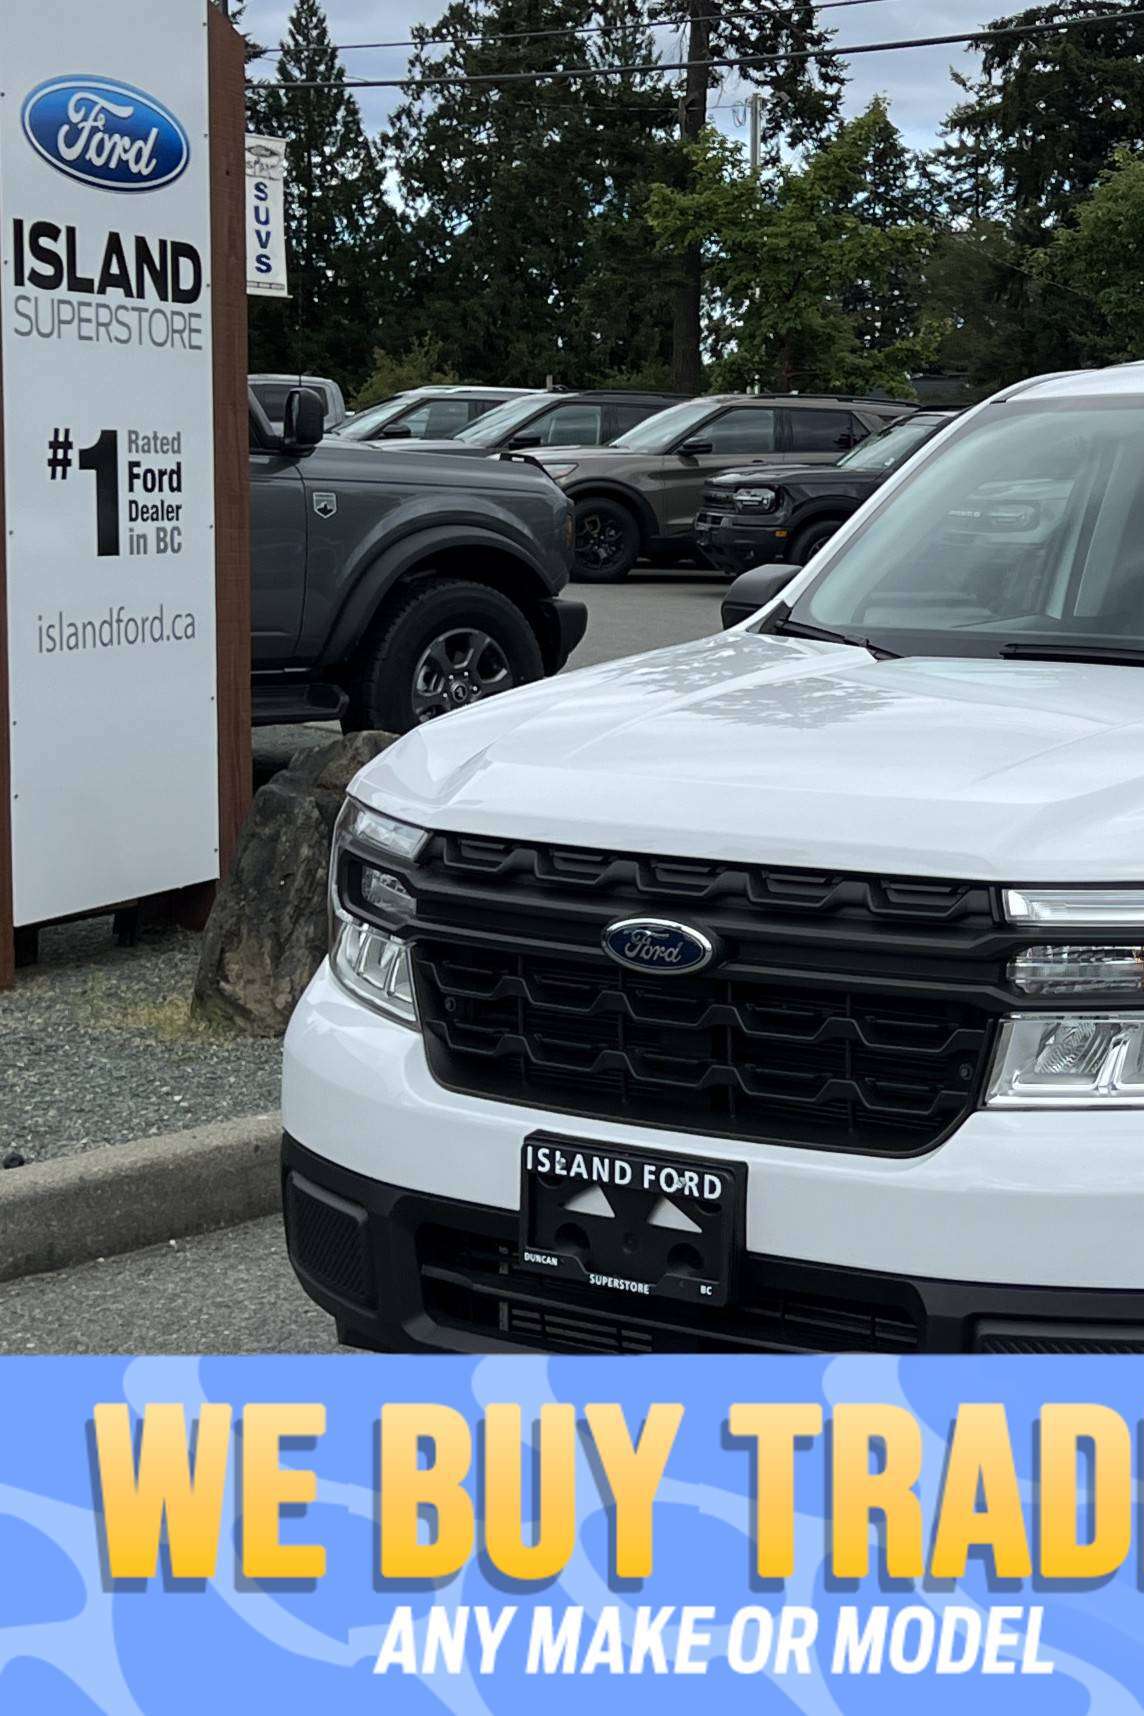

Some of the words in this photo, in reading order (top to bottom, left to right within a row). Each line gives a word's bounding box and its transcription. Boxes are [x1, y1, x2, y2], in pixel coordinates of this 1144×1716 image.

[57, 91, 158, 177] Ford
[253, 181, 273, 275] SUVS
[12, 217, 203, 305] ISLAND
[13, 295, 204, 351] SUPERSTORE
[127, 429, 182, 455] Rated
[46, 427, 121, 558] #1
[127, 460, 183, 494] Ford
[128, 499, 183, 523] Dealer
[128, 528, 148, 556] in
[155, 525, 183, 555] BC
[37, 603, 197, 654] islandford.ca
[622, 928, 684, 964] Ford
[526, 1145, 633, 1186] ISLAND
[643, 1164, 723, 1200] FORD
[523, 1251, 559, 1267] DUNCAN
[588, 1272, 650, 1295] SUPERSTORE
[700, 1284, 713, 1297] BC
